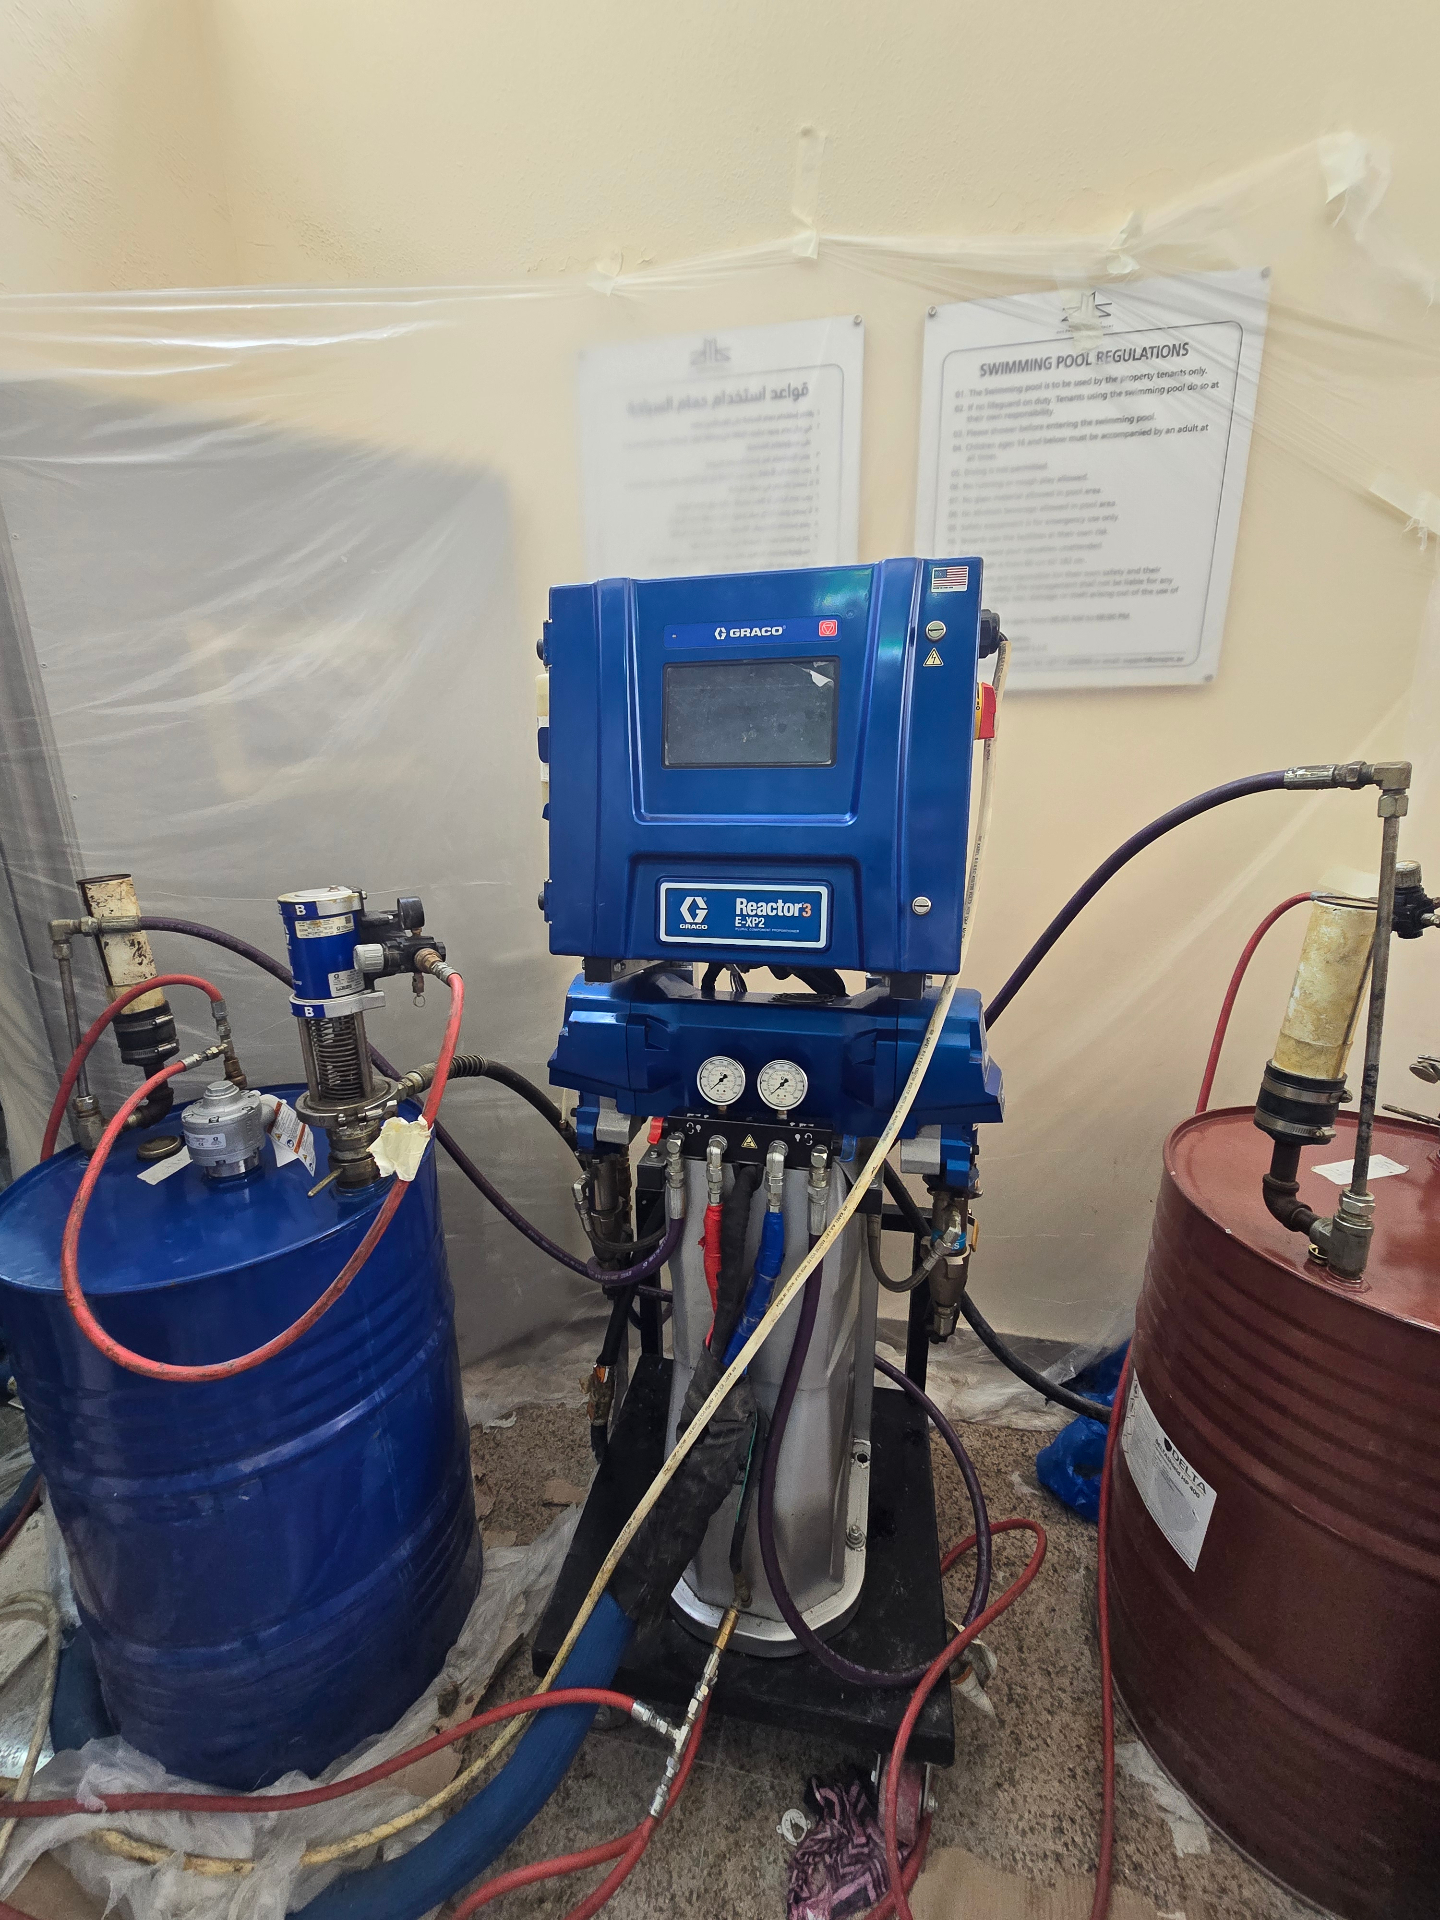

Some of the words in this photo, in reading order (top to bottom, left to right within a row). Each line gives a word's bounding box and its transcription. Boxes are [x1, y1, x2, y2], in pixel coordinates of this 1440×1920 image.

[980, 356, 1053, 378] SWIMMING
[1056, 351, 1093, 370] POOL
[1096, 342, 1190, 366] REGULATIONS
[770, 381, 809, 403] قواعد
[969, 389, 983, 397] The
[1024, 382, 1043, 394] pool
[1052, 381, 1061, 389] to
[1062, 379, 1072, 388] be
[1074, 376, 1092, 386] used
[1094, 376, 1104, 387] by
[1105, 374, 1119, 384] the
[1120, 371, 1155, 384] property
[1157, 368, 1187, 379] tenants
[1188, 366, 1208, 377] only.
[1056, 394, 1086, 403] Tenants
[1087, 391, 1108, 402] using
[1110, 389, 1123, 398] the
[1124, 385, 1166, 398] swimming
[1167, 382, 1186, 395] pool
[1187, 381, 1198, 391] do
[1200, 382, 1209, 391] so
[1210, 380, 1220, 389] at
[712, 385, 766, 410] استخدام
[1046, 420, 1079, 431] entering
[1080, 419, 1092, 427] the
[1095, 415, 1134, 427] swimming
[1136, 411, 1157, 423] pool.
[1089, 432, 1099, 441] be
[1100, 427, 1152, 440] accompanied
[1153, 426, 1164, 437] by
[1165, 426, 1176, 434] an
[1177, 423, 1199, 434] adult
[1200, 423, 1209, 432] at
[729, 626, 783, 638] GRACO
[295, 905, 307, 916] B
[735, 916, 765, 928] E-XP2
[304, 1006, 315, 1017] B
[1171, 1450, 1207, 1496] DELTA
